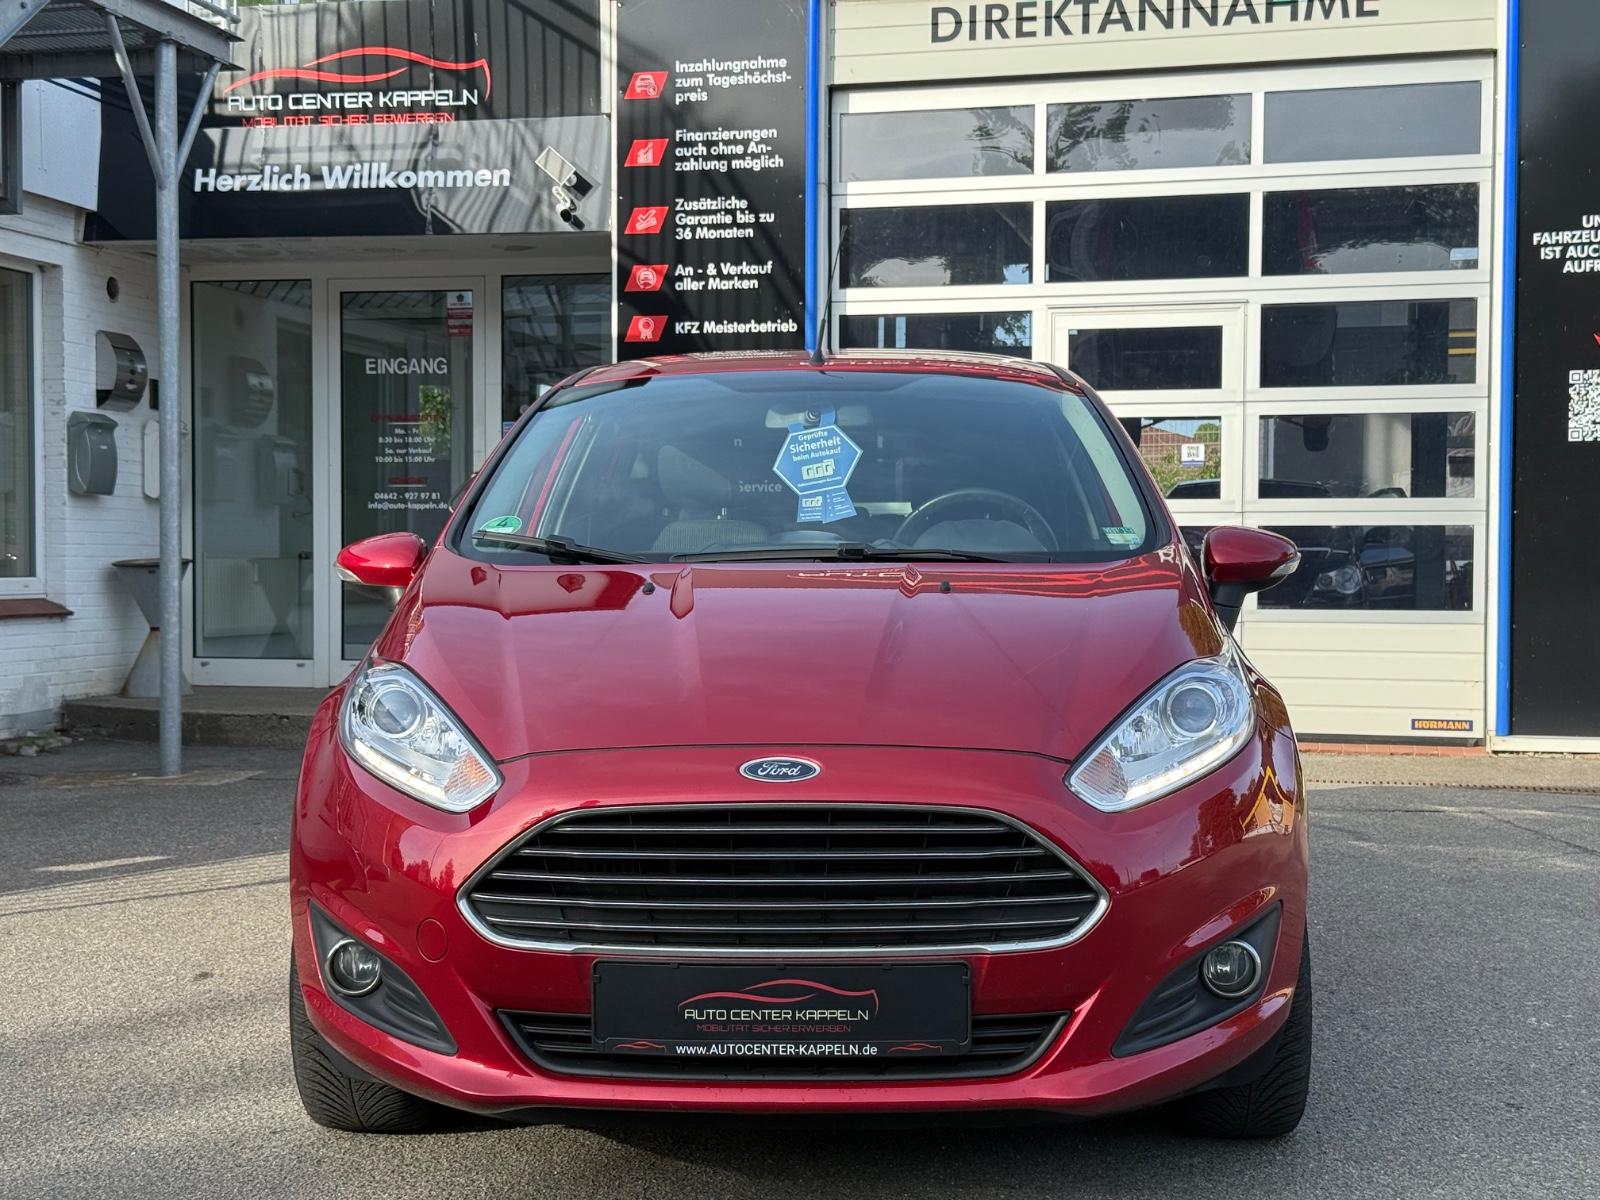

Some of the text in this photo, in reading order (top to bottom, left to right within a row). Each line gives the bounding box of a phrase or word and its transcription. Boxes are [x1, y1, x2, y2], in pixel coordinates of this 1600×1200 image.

[675, 56, 788, 73] Inzahlungnahme
[675, 71, 792, 88] zum Tageshöchst-
[228, 89, 478, 111] AUTO CENTER KAPPELN
[675, 88, 708, 105] preis
[318, 114, 369, 127] SICHER
[675, 127, 778, 142] Finanzierungen
[675, 142, 772, 157] auch ohne An-
[675, 155, 784, 172] zahlung möglich
[193, 162, 511, 193] Herzlich Willkommen
[675, 195, 748, 211] Zusätzliche
[675, 210, 775, 226] Garantie bis zu
[675, 227, 754, 240] 36 Monaten
[1532, 230, 1600, 245] FAHRZEU
[1540, 244, 1600, 260] IST AUC
[674, 264, 694, 277] An
[706, 263, 717, 276] &
[720, 260, 773, 276] Verkauf
[1562, 259, 1600, 273] AUFR
[675, 276, 759, 291] aller Marken
[675, 319, 798, 334] KFZ Meisterbetrieb
[365, 357, 448, 375] EINGANG
[798, 431, 828, 441] Geprüfte
[790, 436, 842, 454] Sicherheit
[792, 446, 841, 462] beim Autokauf
[404, 491, 419, 500] 927
[420, 491, 430, 500] 97
[496, 517, 508, 528] 4
[757, 760, 801, 776] Ford
[684, 1009, 869, 1021] AUTO CENTER KAPPELN
[751, 1023, 791, 1033] SICHER
[791, 1023, 851, 1033] ERWERBEN
[676, 1043, 878, 1056] www.AUTOCENTER-KAPPELN.de
